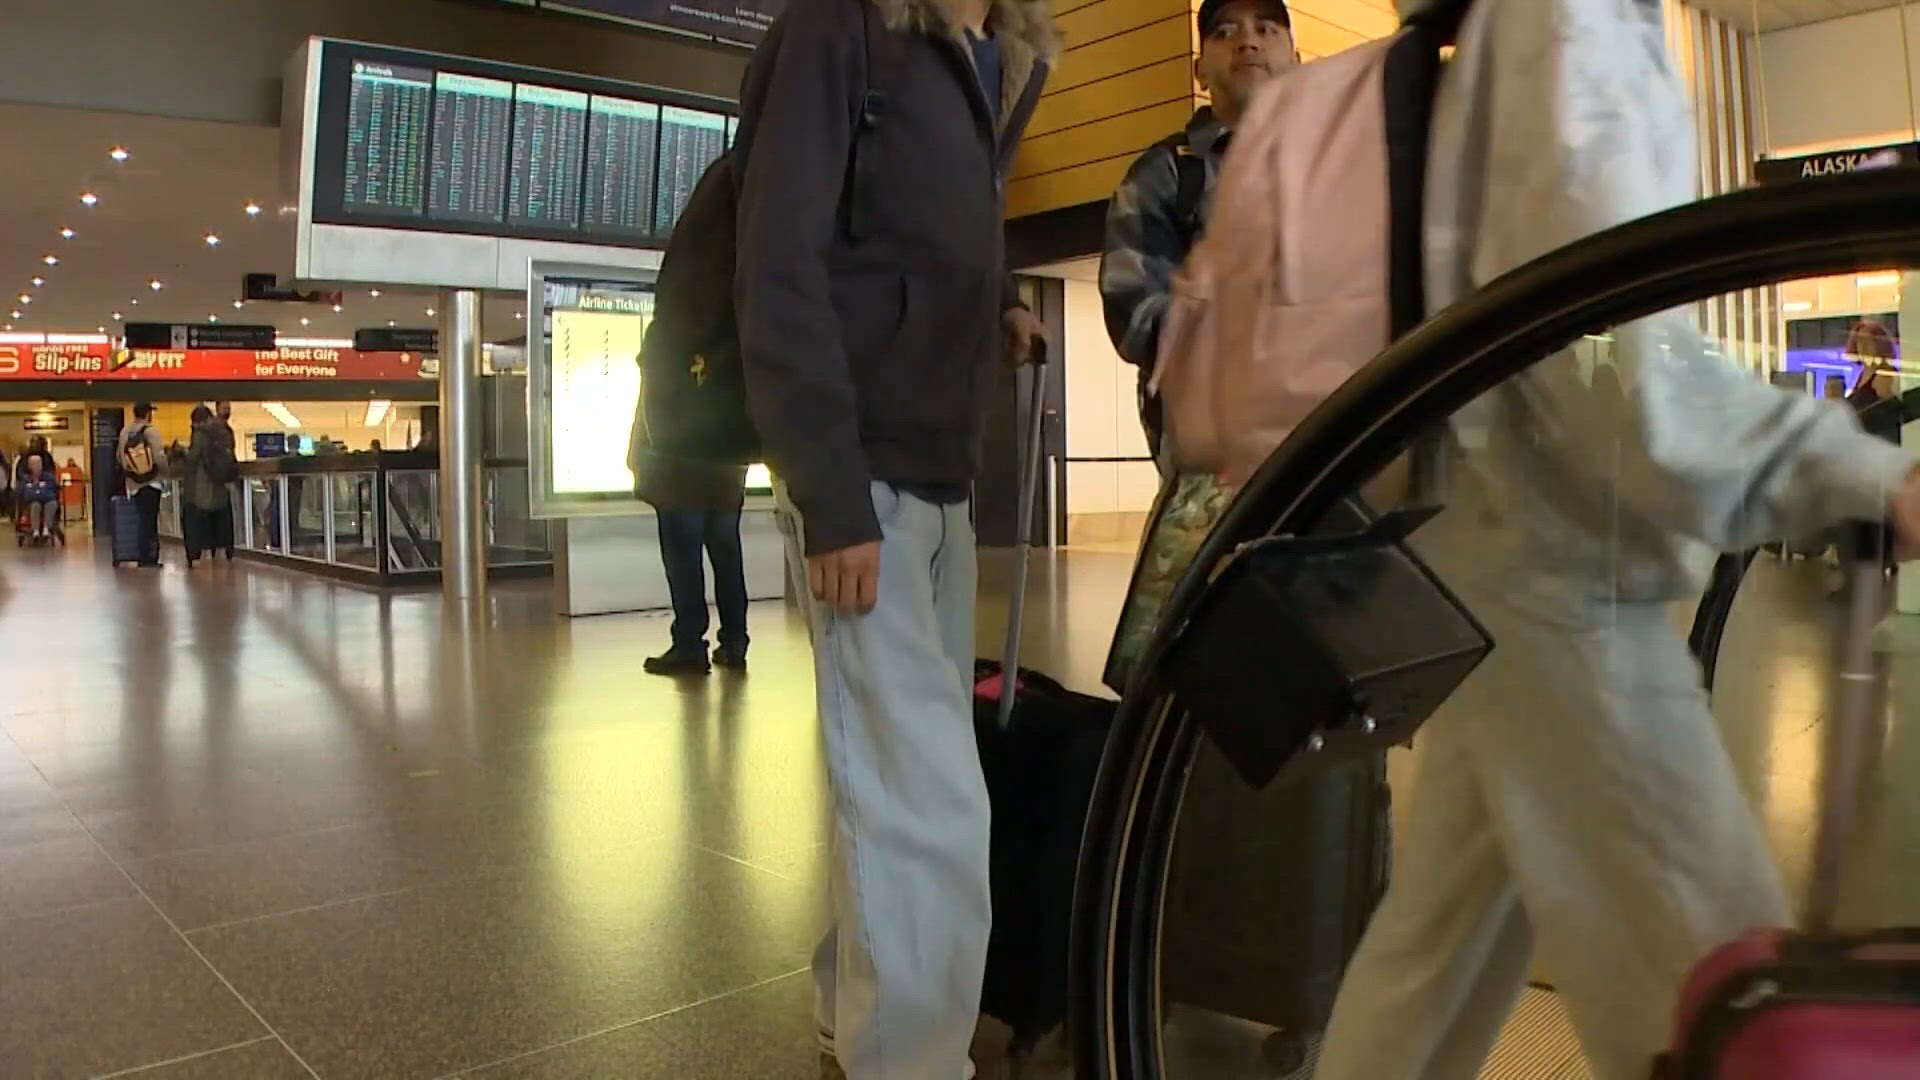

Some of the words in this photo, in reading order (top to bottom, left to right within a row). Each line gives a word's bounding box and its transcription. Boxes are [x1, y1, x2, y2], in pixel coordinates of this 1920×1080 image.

[578, 295, 613, 310] Airline
[615, 298, 655, 313] Ticketin
[279, 348, 312, 361] Best
[312, 349, 341, 362] Gift
[255, 363, 276, 376] for
[276, 363, 338, 378] Everyone
